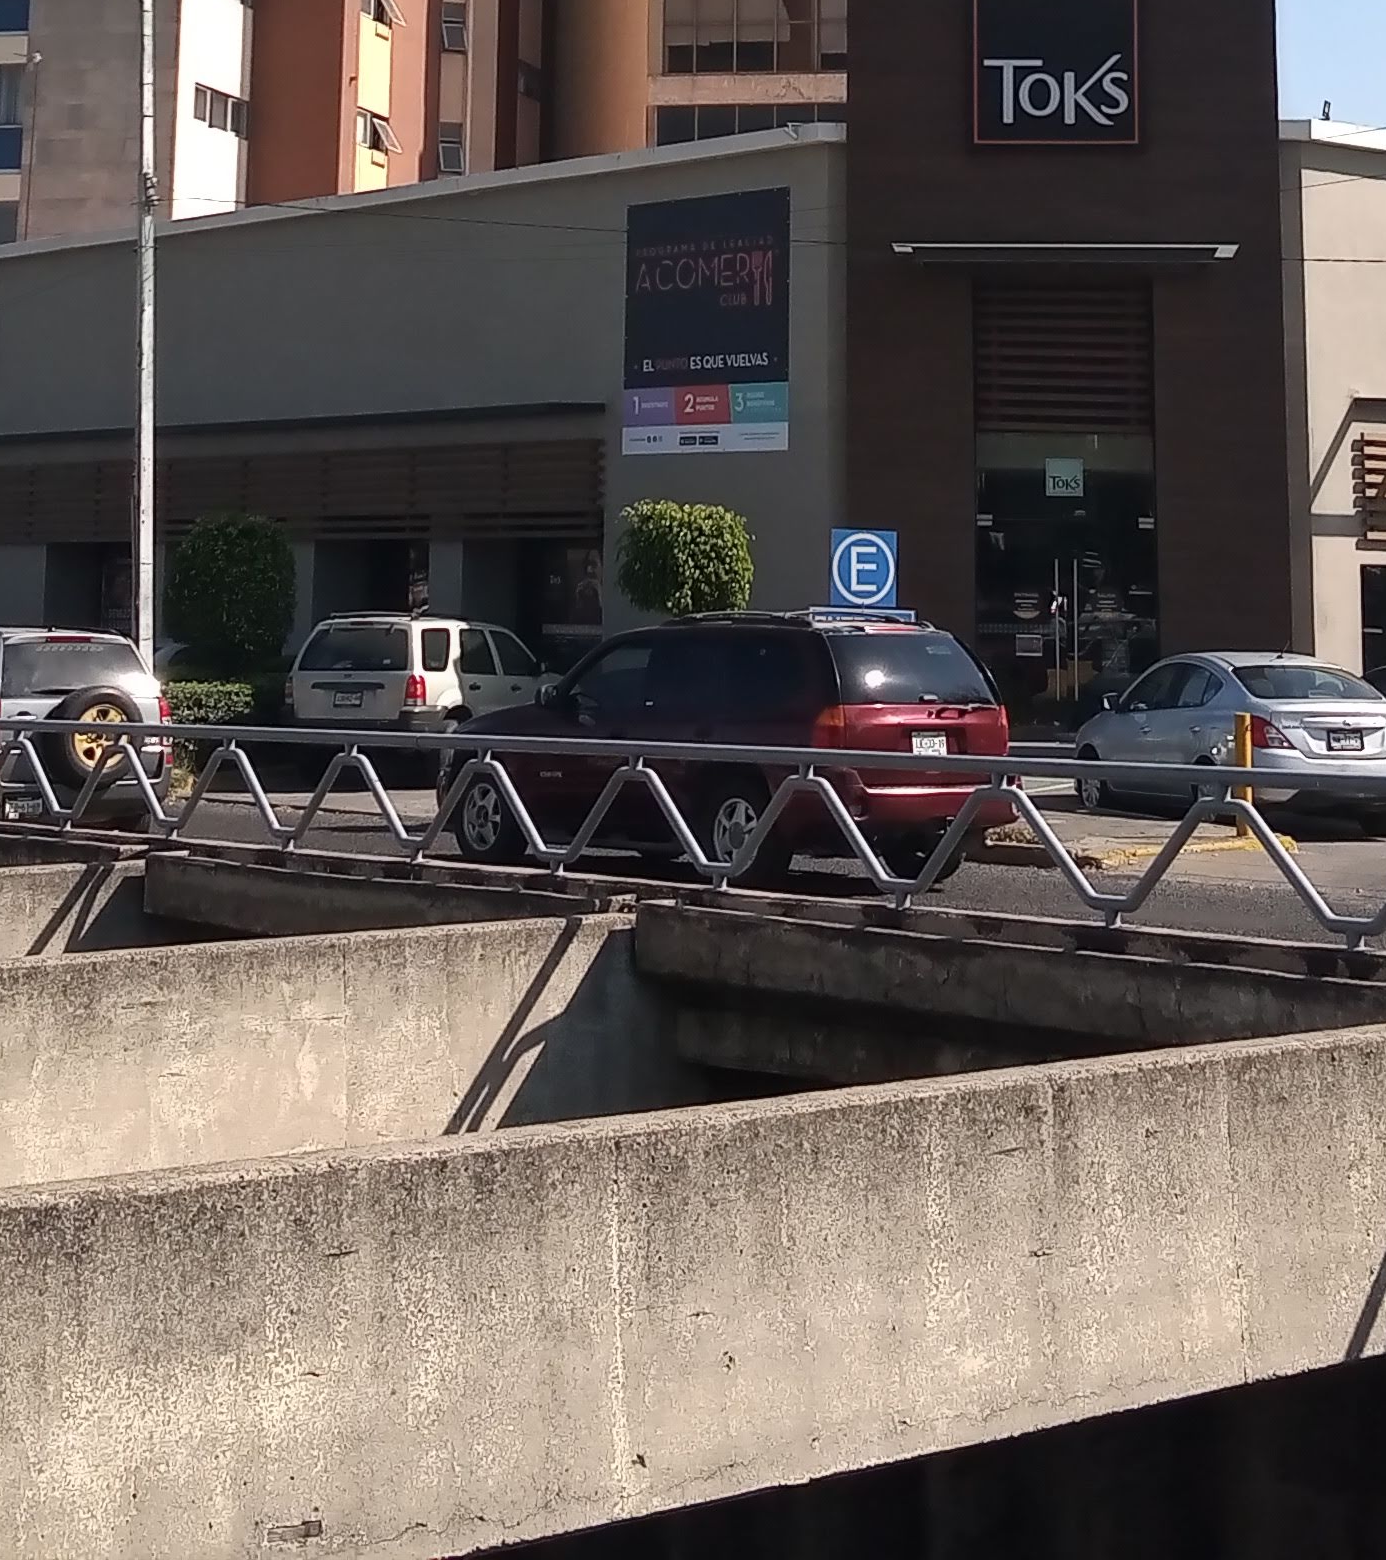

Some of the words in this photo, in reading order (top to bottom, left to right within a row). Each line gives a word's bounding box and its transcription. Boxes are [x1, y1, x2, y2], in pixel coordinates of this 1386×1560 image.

[720, 293, 747, 306] CLUB
[643, 359, 655, 372] EL
[657, 357, 688, 371] PUNTO
[690, 356, 702, 370] ES
[703, 354, 725, 369] QUE
[726, 352, 769, 367] VUELVAS
[633, 396, 640, 415] 1
[684, 393, 695, 413] 2
[735, 392, 745, 412] 3
[850, 546, 878, 591] E
